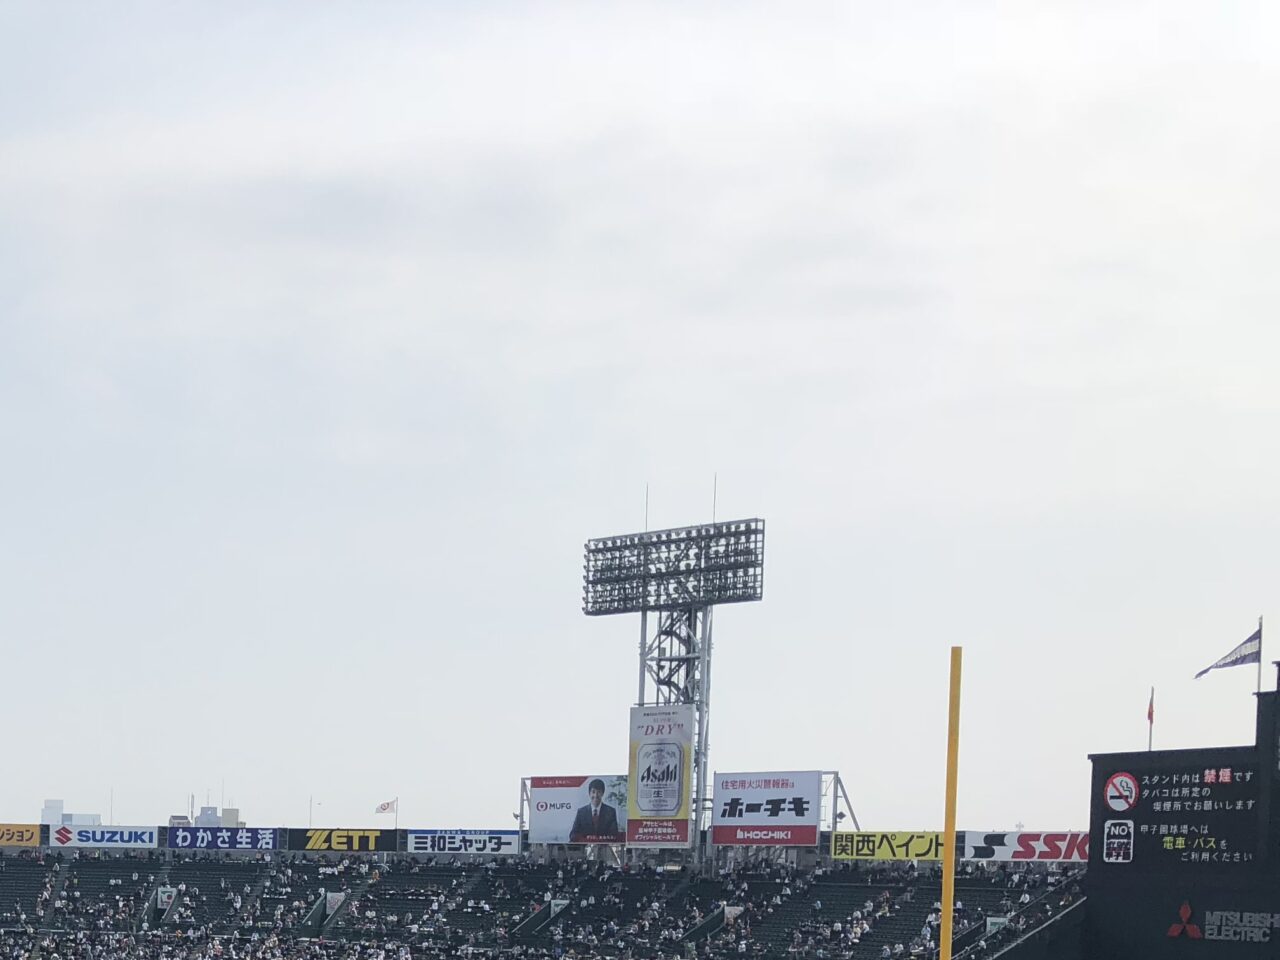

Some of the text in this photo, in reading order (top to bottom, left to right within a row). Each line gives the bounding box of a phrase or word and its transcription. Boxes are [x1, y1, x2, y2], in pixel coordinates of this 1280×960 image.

[640, 764, 678, 783] Asahi
[721, 779, 795, 790] 住宅用火災警報器は
[652, 790, 664, 798] 生
[1141, 787, 1212, 799] タバコは所定の
[721, 797, 810, 818] ホーチキ
[1153, 799, 1256, 812] 喫煙所でお願いします
[744, 830, 791, 840] HOCHIKI
[1110, 825, 1128, 835] NO
[1140, 825, 1209, 835] 甲子園球場へは
[77, 830, 154, 844] SUZUKI
[176, 828, 274, 849] わかさ生活
[305, 830, 381, 850] ZETT
[414, 836, 512, 852] 三和シャッター
[1011, 834, 1089, 860] SSK
[1181, 851, 1253, 862] ご利用ください
[1205, 927, 1270, 942] ELECTRIC
